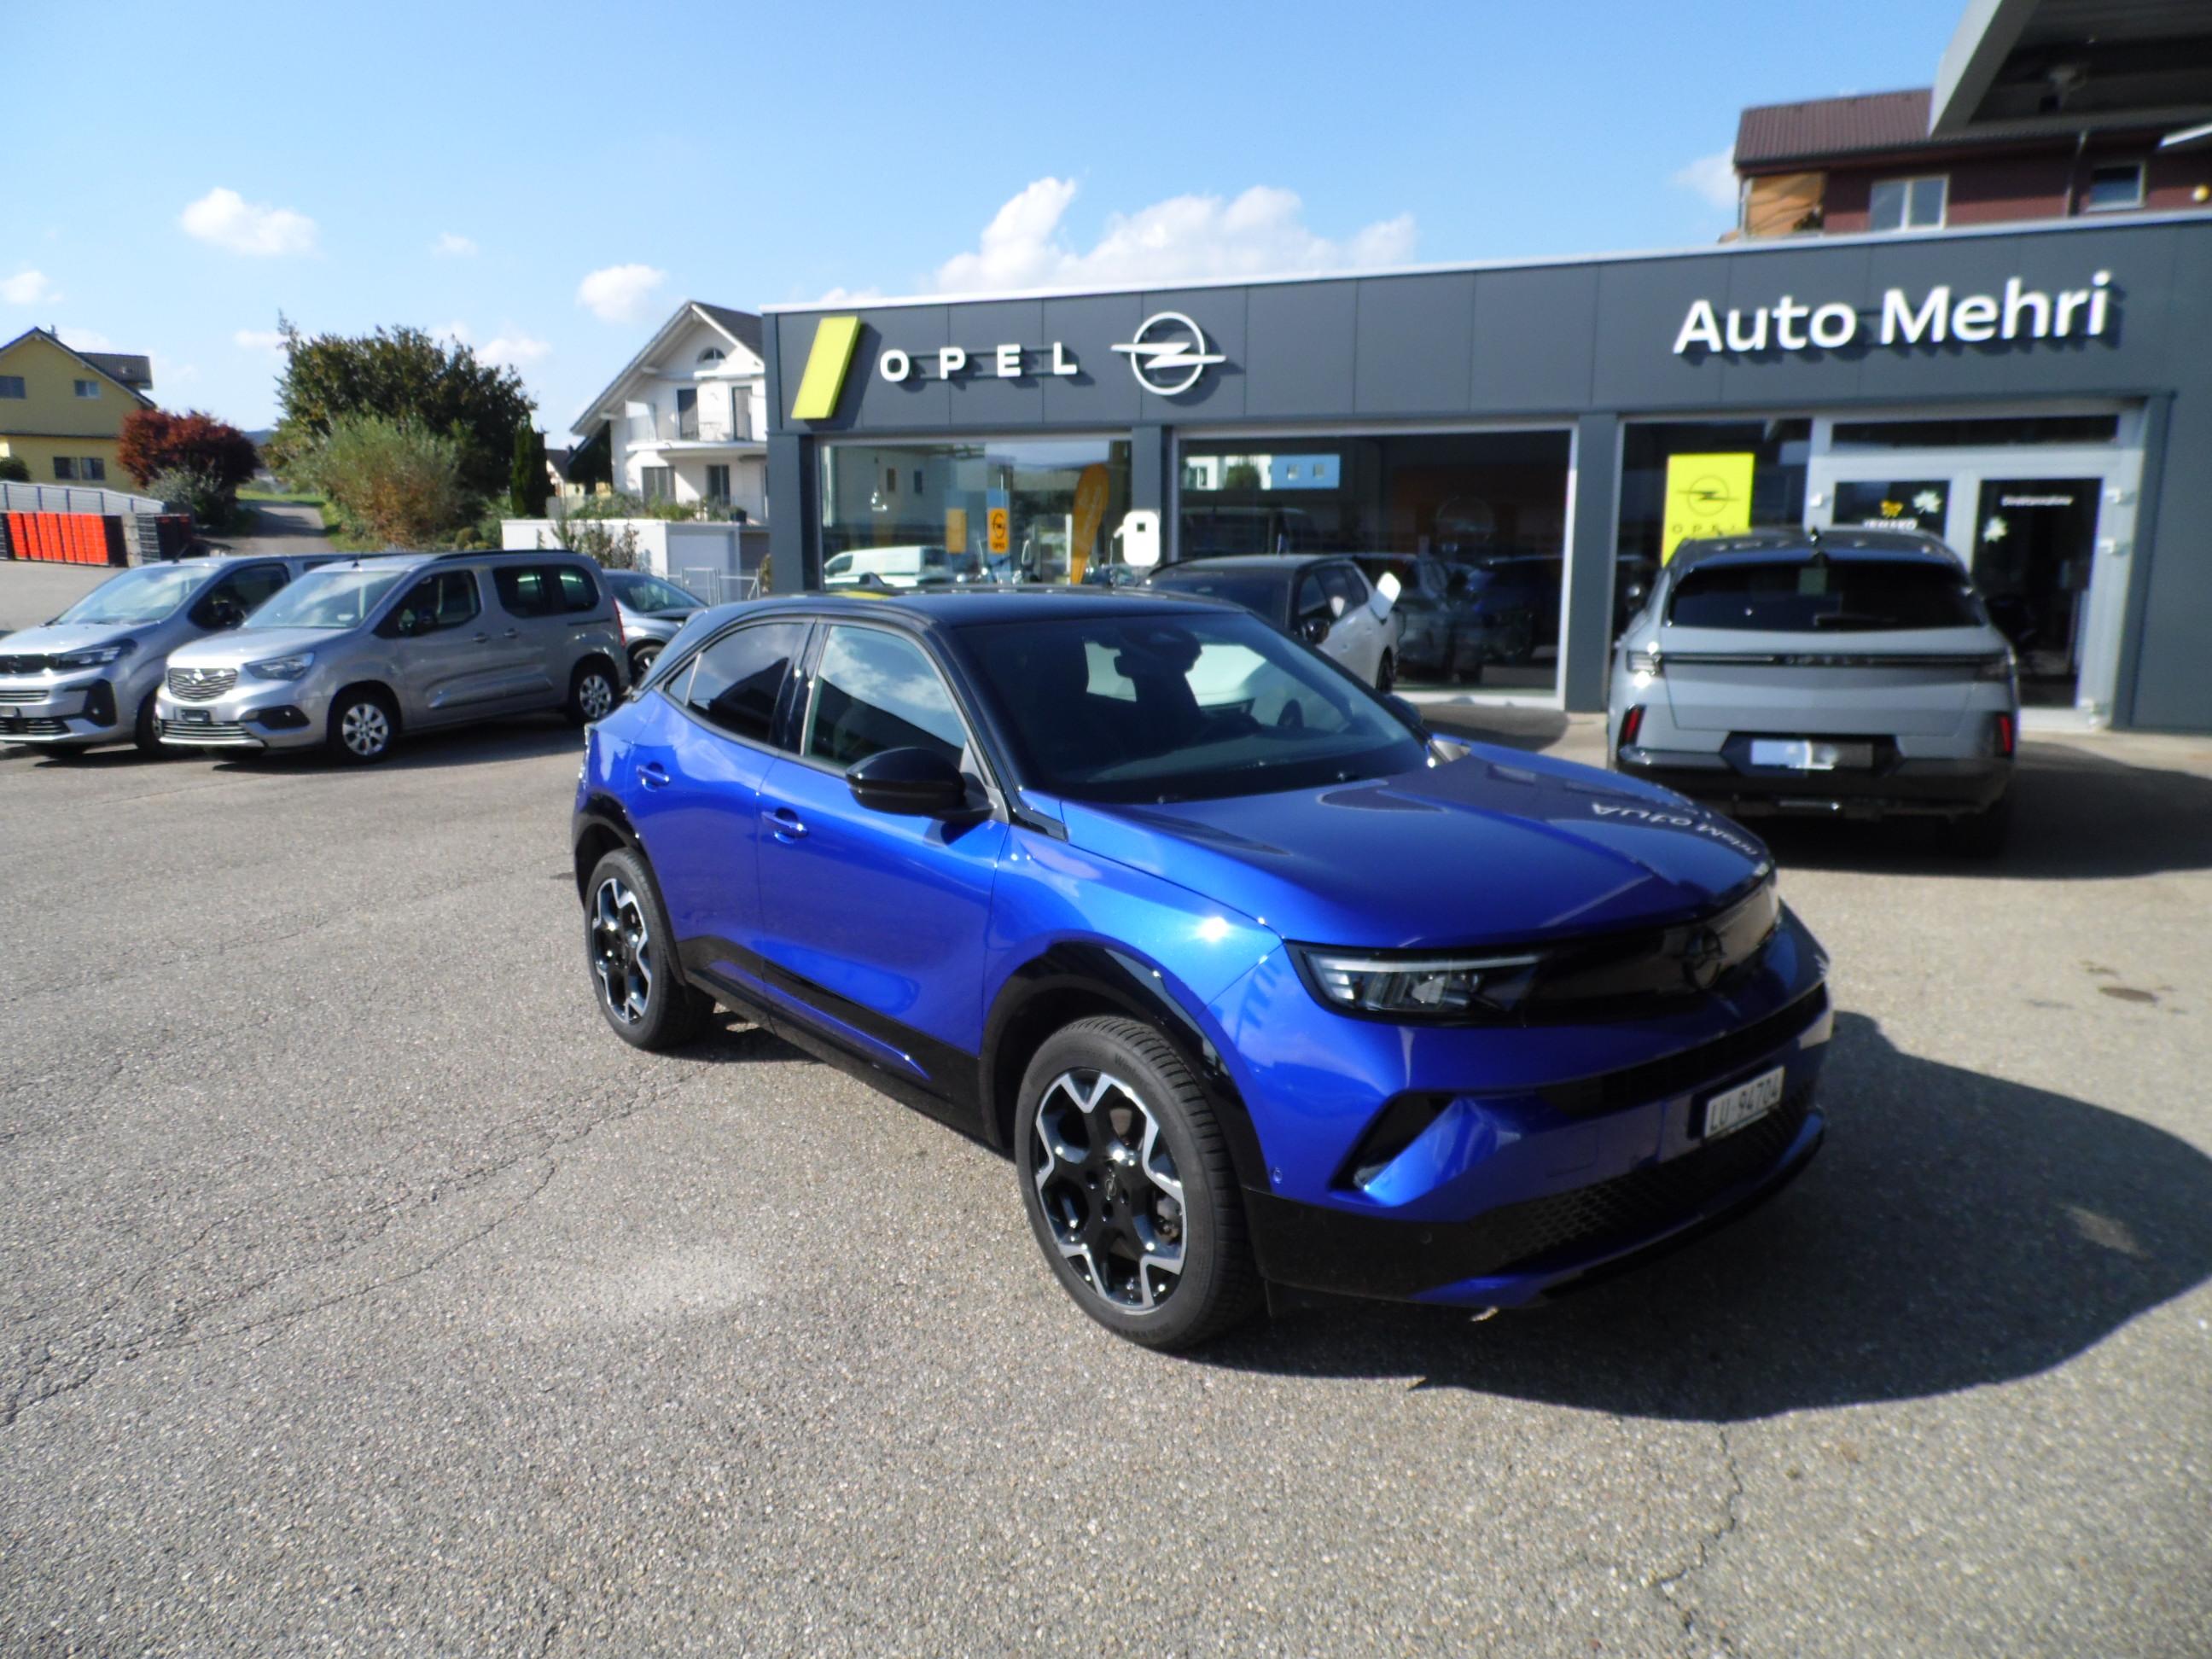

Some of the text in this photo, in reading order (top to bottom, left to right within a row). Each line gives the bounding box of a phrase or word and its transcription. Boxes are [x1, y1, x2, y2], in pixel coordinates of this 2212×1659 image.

[1674, 271, 2110, 354] Auto Mehri
[880, 342, 1077, 382] OPEL
